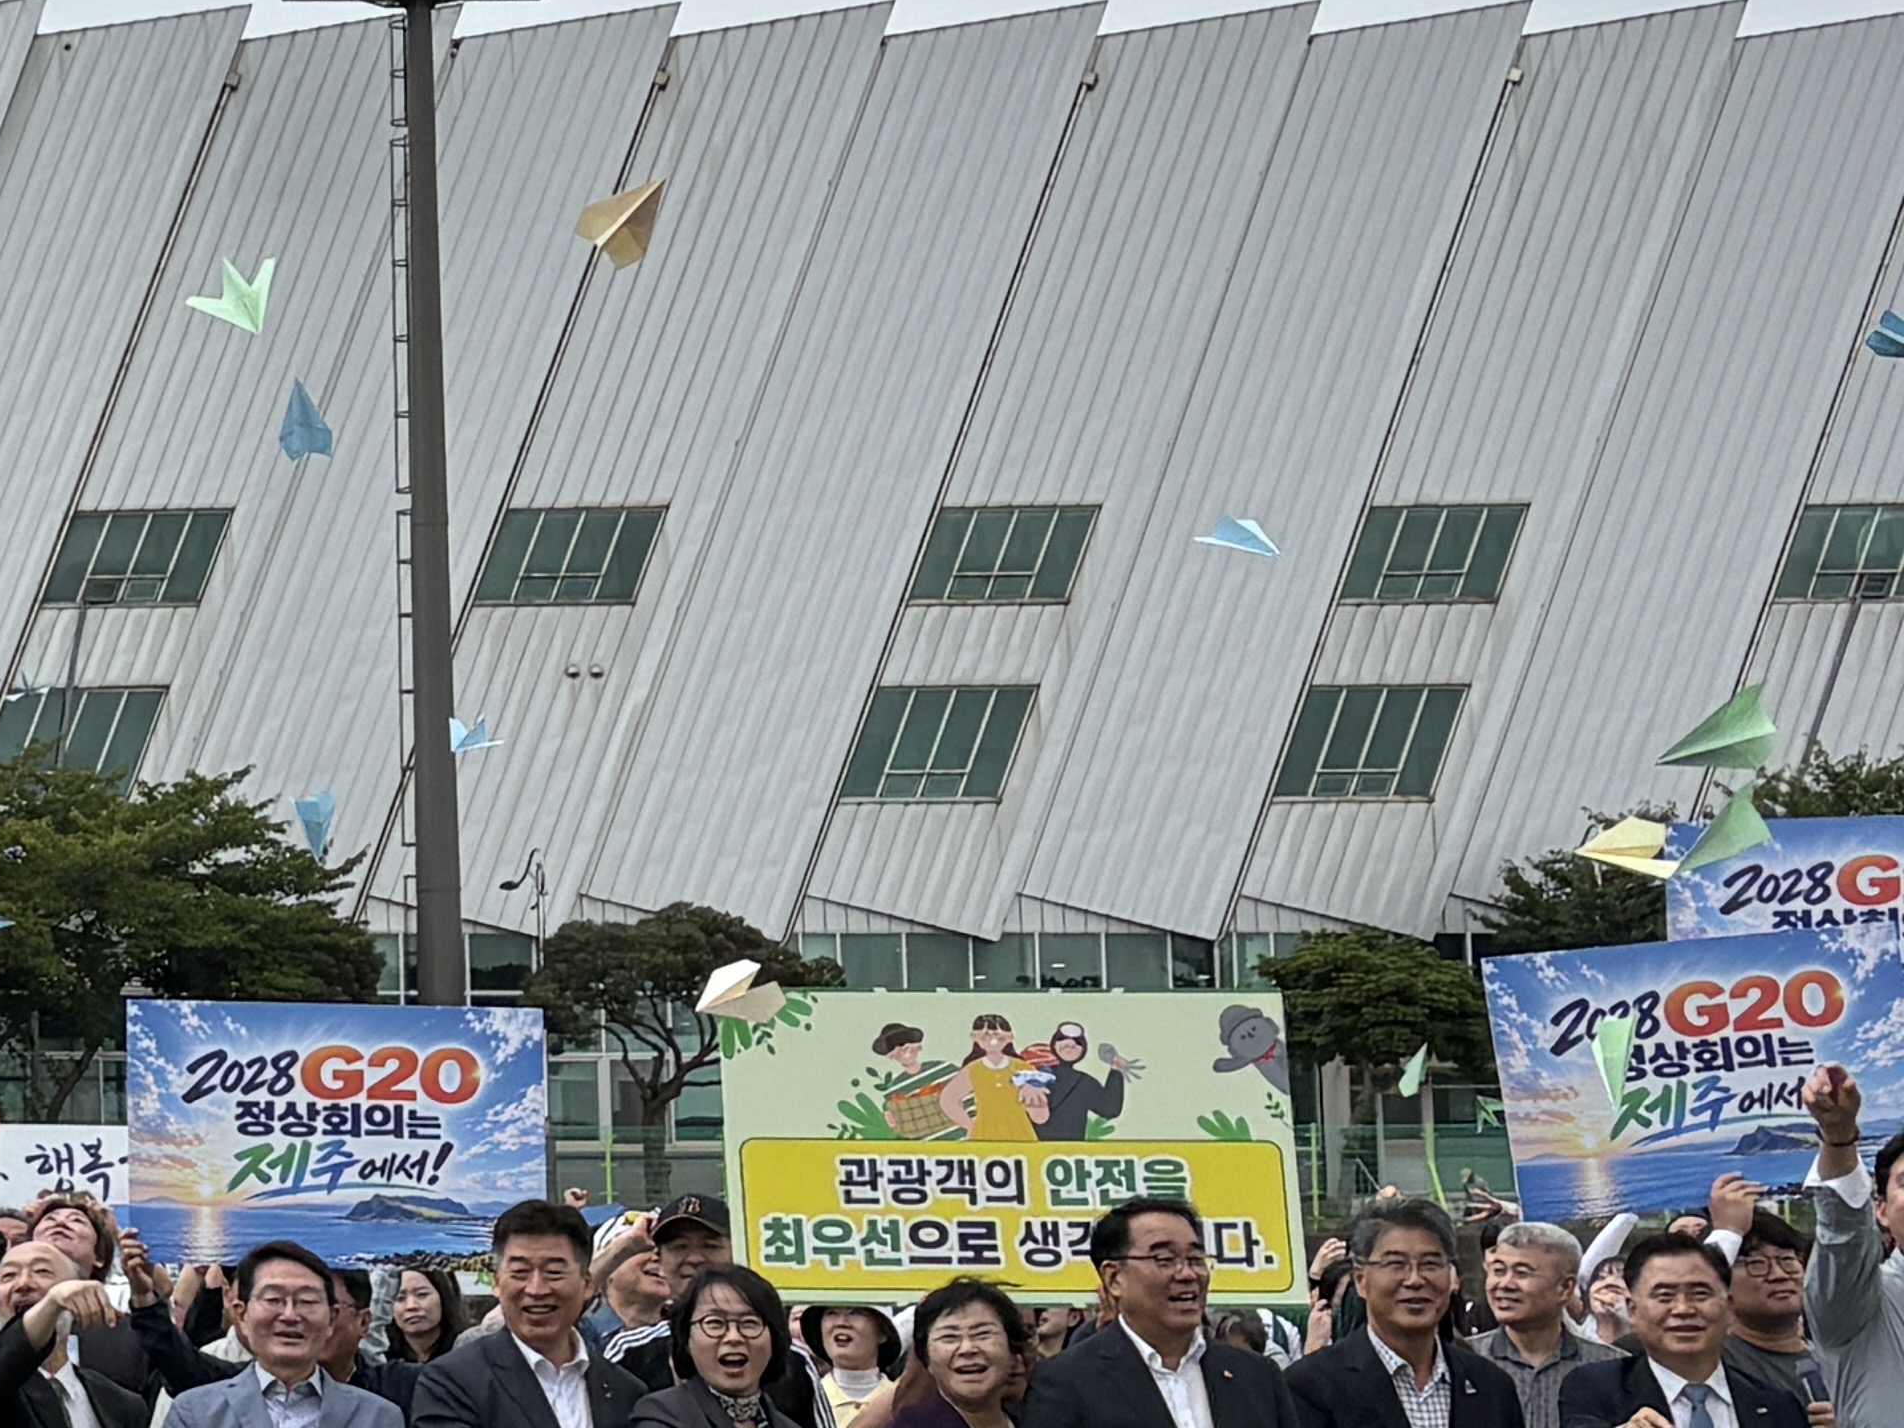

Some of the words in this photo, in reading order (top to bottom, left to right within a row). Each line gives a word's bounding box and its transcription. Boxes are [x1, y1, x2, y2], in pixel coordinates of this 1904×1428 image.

[1719, 860, 1835, 916] 2028
[1664, 970, 1845, 1037] G20
[181, 1048, 300, 1105] 2028
[300, 1044, 482, 1105] G20
[234, 1099, 442, 1140] 정상회의는
[839, 1157, 1026, 1206] 관광객의
[1045, 1158, 1187, 1207] 안전을
[763, 1216, 1001, 1267] 최우선으로
